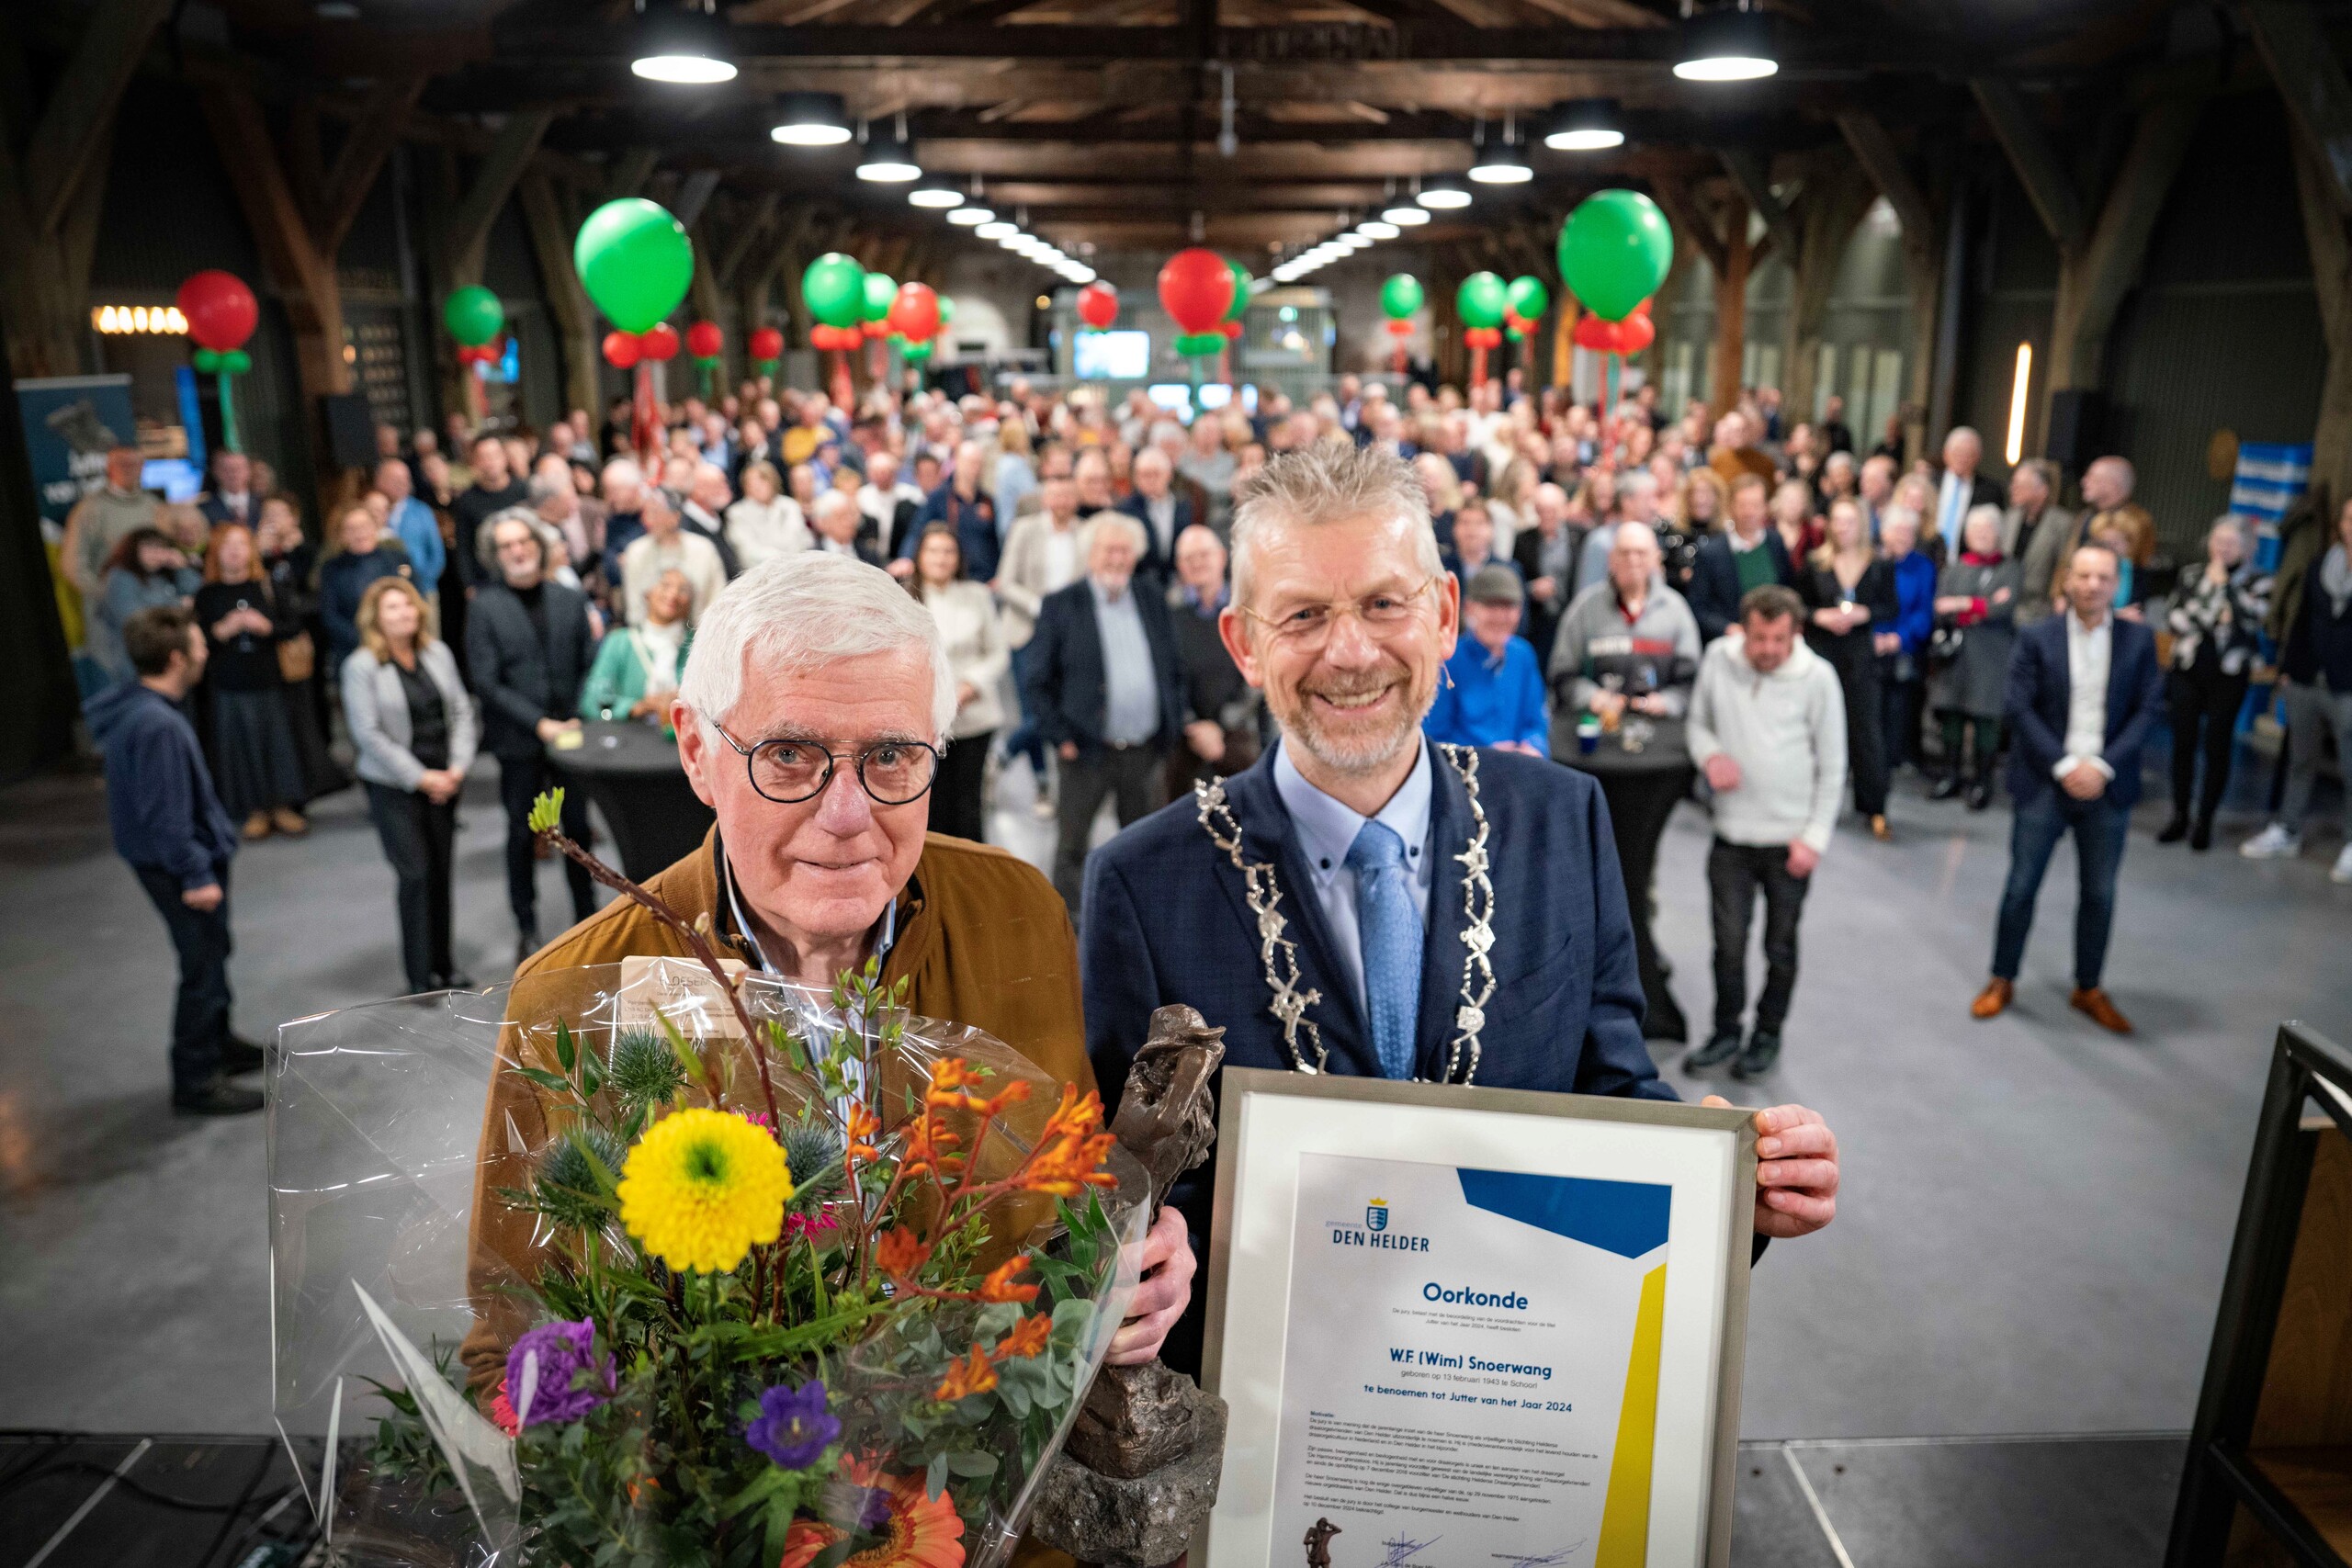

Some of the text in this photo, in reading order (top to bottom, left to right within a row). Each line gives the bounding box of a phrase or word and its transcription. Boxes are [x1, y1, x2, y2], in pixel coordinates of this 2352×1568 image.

[1324, 1220, 1363, 1229] gemeente
[1333, 1229, 1429, 1252] DEN HELDER
[1423, 1282, 1528, 1310] Oorkonde
[1390, 1348, 1552, 1380] W.F. (Wim) Snoerwang
[1400, 1370, 1430, 1378] geboren
[1453, 1374, 1480, 1383] februari
[1483, 1377, 1499, 1385] 1943
[1510, 1379, 1537, 1388] Schoorl
[1363, 1384, 1374, 1393] te
[1376, 1384, 1428, 1398] benoemen
[1430, 1391, 1446, 1399] tot
[1450, 1392, 1477, 1403] Jutter
[1500, 1397, 1517, 1406] het
[1521, 1399, 1543, 1409] Jaar
[1545, 1401, 1572, 1412] 2024
